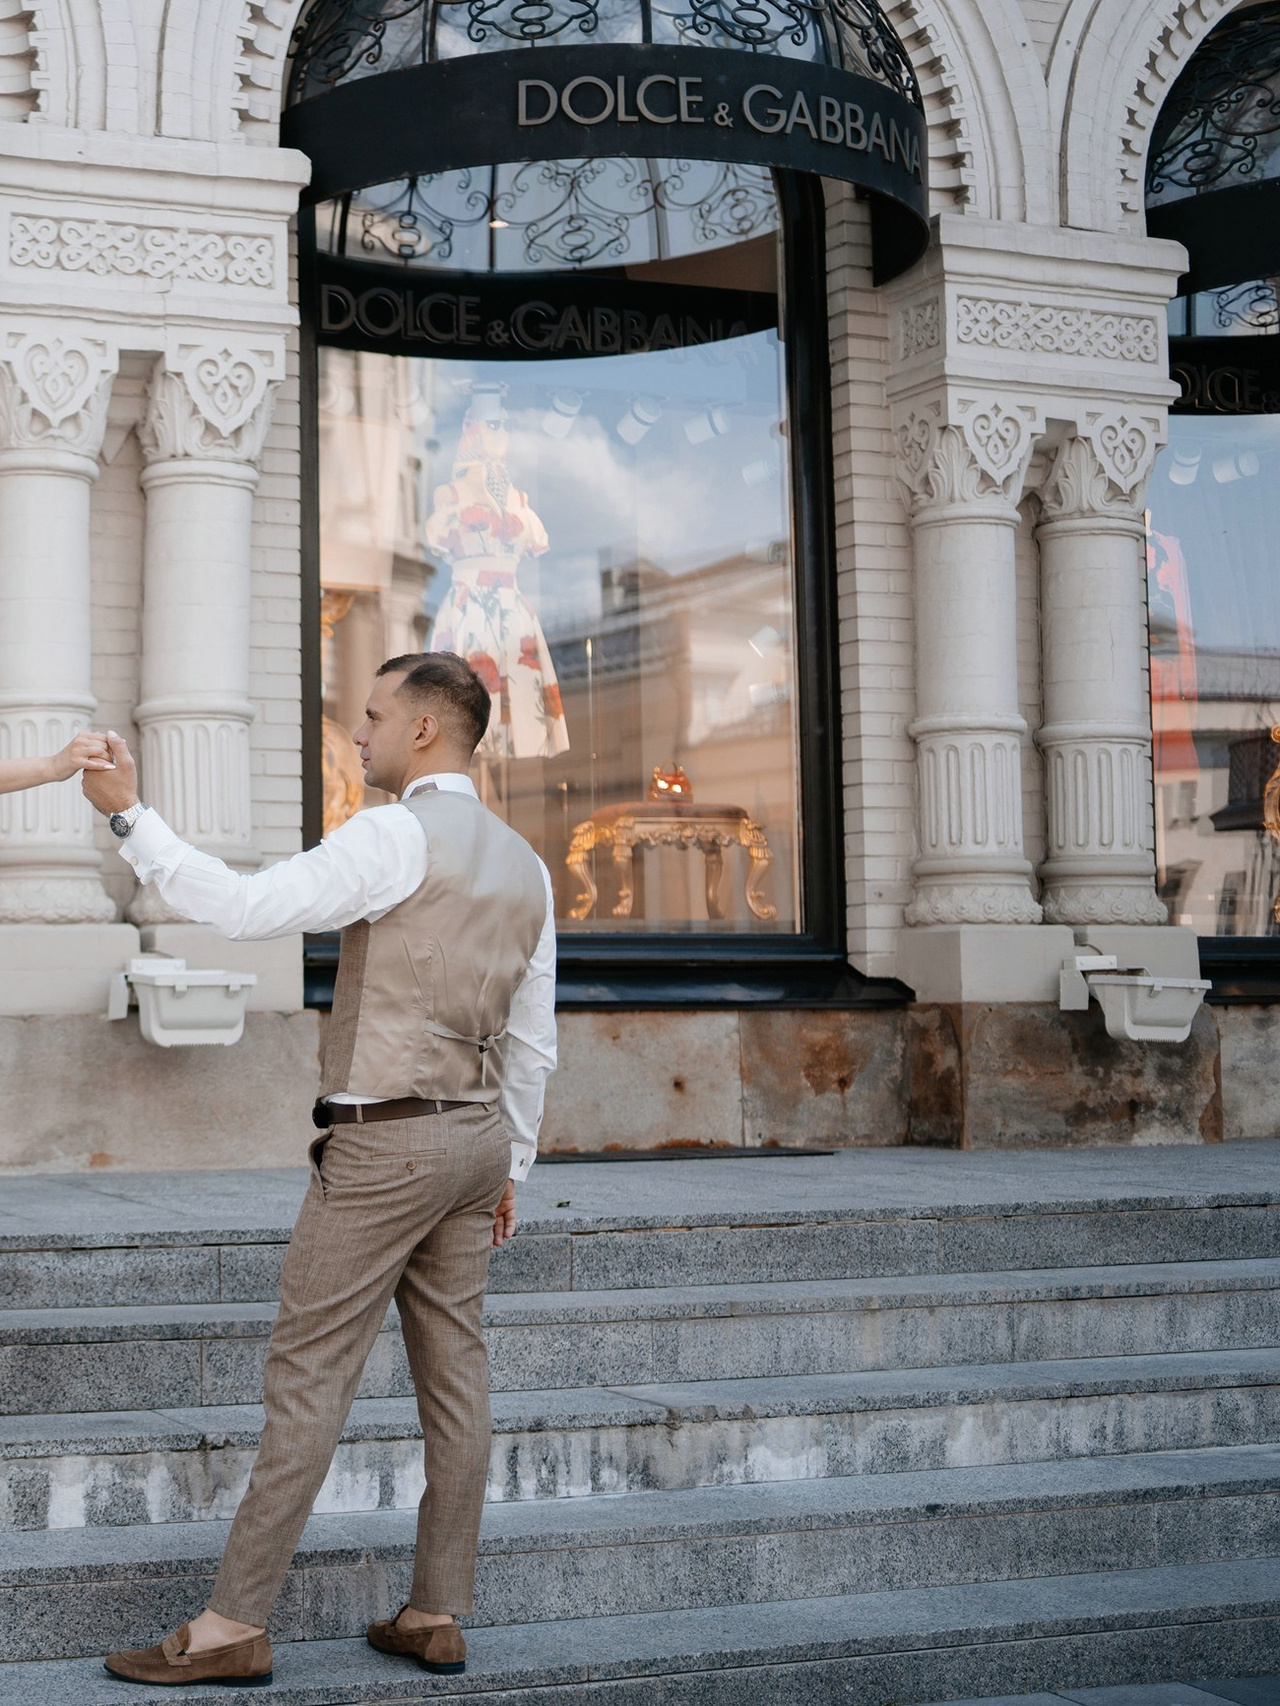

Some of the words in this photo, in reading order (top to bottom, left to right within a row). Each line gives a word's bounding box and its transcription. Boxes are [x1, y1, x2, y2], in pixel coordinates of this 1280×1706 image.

[518, 74, 704, 127] DOLCE
[714, 102, 734, 128] &
[742, 83, 923, 184] GABBANA
[320, 284, 482, 345] DOLCE
[486, 319, 511, 347] &
[1170, 361, 1261, 412] OLCE
